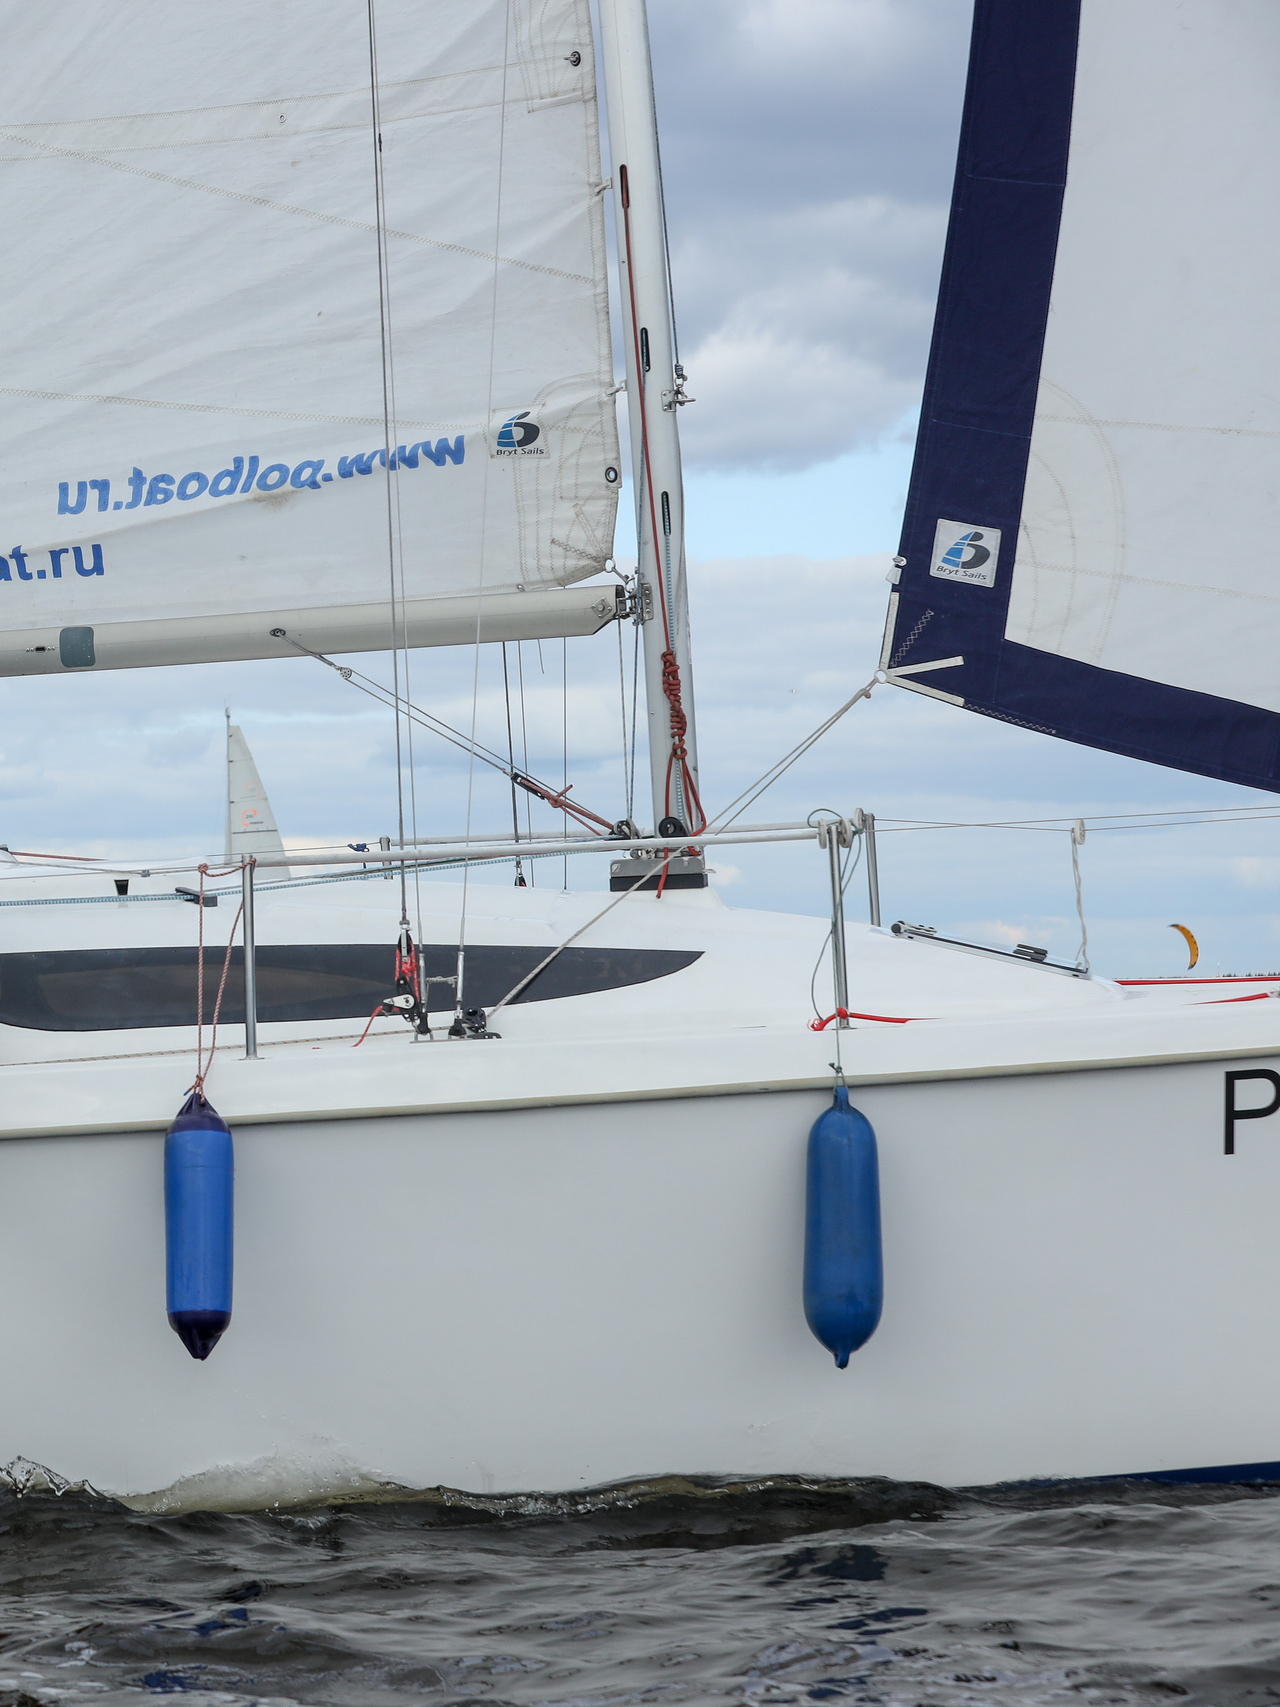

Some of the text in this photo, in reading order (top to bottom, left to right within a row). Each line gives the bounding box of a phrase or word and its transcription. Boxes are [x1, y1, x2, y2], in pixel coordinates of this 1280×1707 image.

[496, 447, 545, 456] Bryt Sails
[936, 565, 988, 580] Bryt Sails
